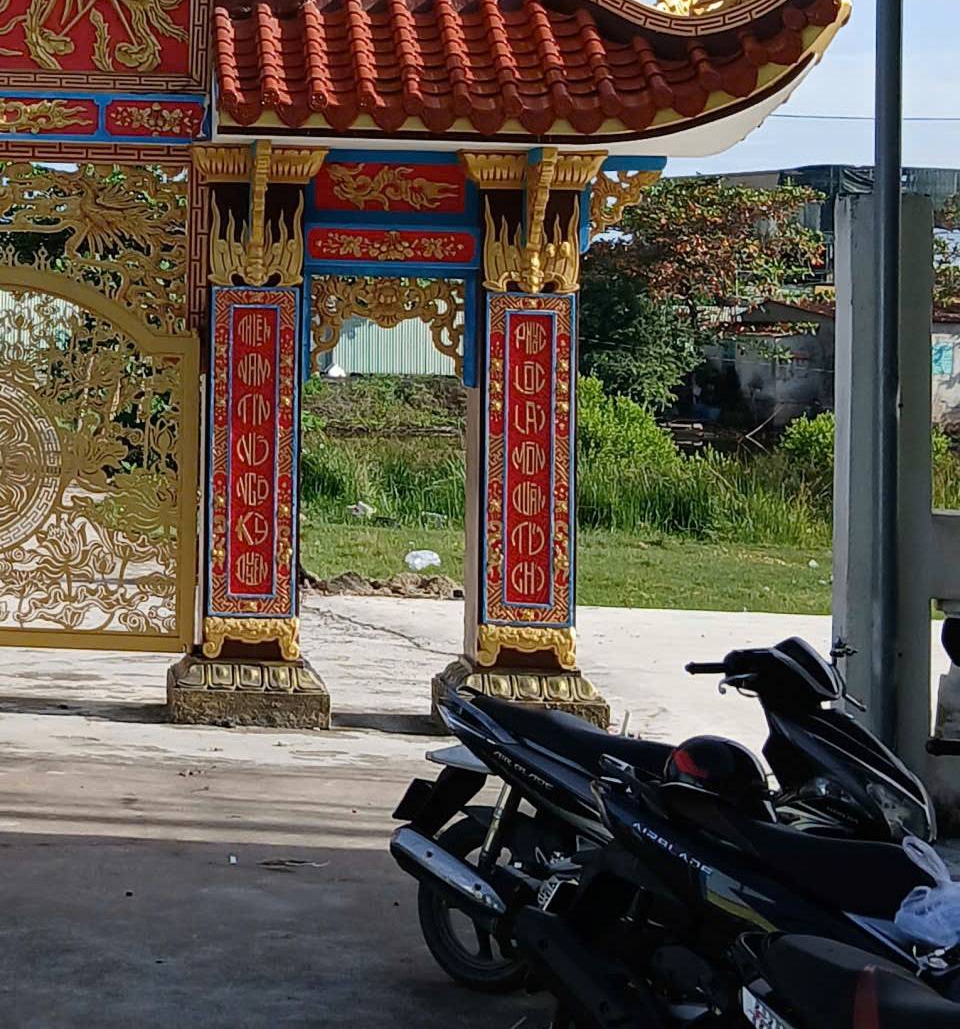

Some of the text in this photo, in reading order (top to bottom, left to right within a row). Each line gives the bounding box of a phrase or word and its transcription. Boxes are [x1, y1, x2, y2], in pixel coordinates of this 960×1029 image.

[238, 313, 271, 347] THIỆN
[237, 353, 271, 386] NAM
[512, 361, 546, 395] LỘC
[237, 393, 270, 426] TÍN
[236, 432, 269, 466] NỮ
[512, 442, 546, 475] MÔN
[236, 472, 269, 506] NGỘ
[512, 482, 545, 516] QUÂN
[235, 551, 268, 586] DUYÊN
